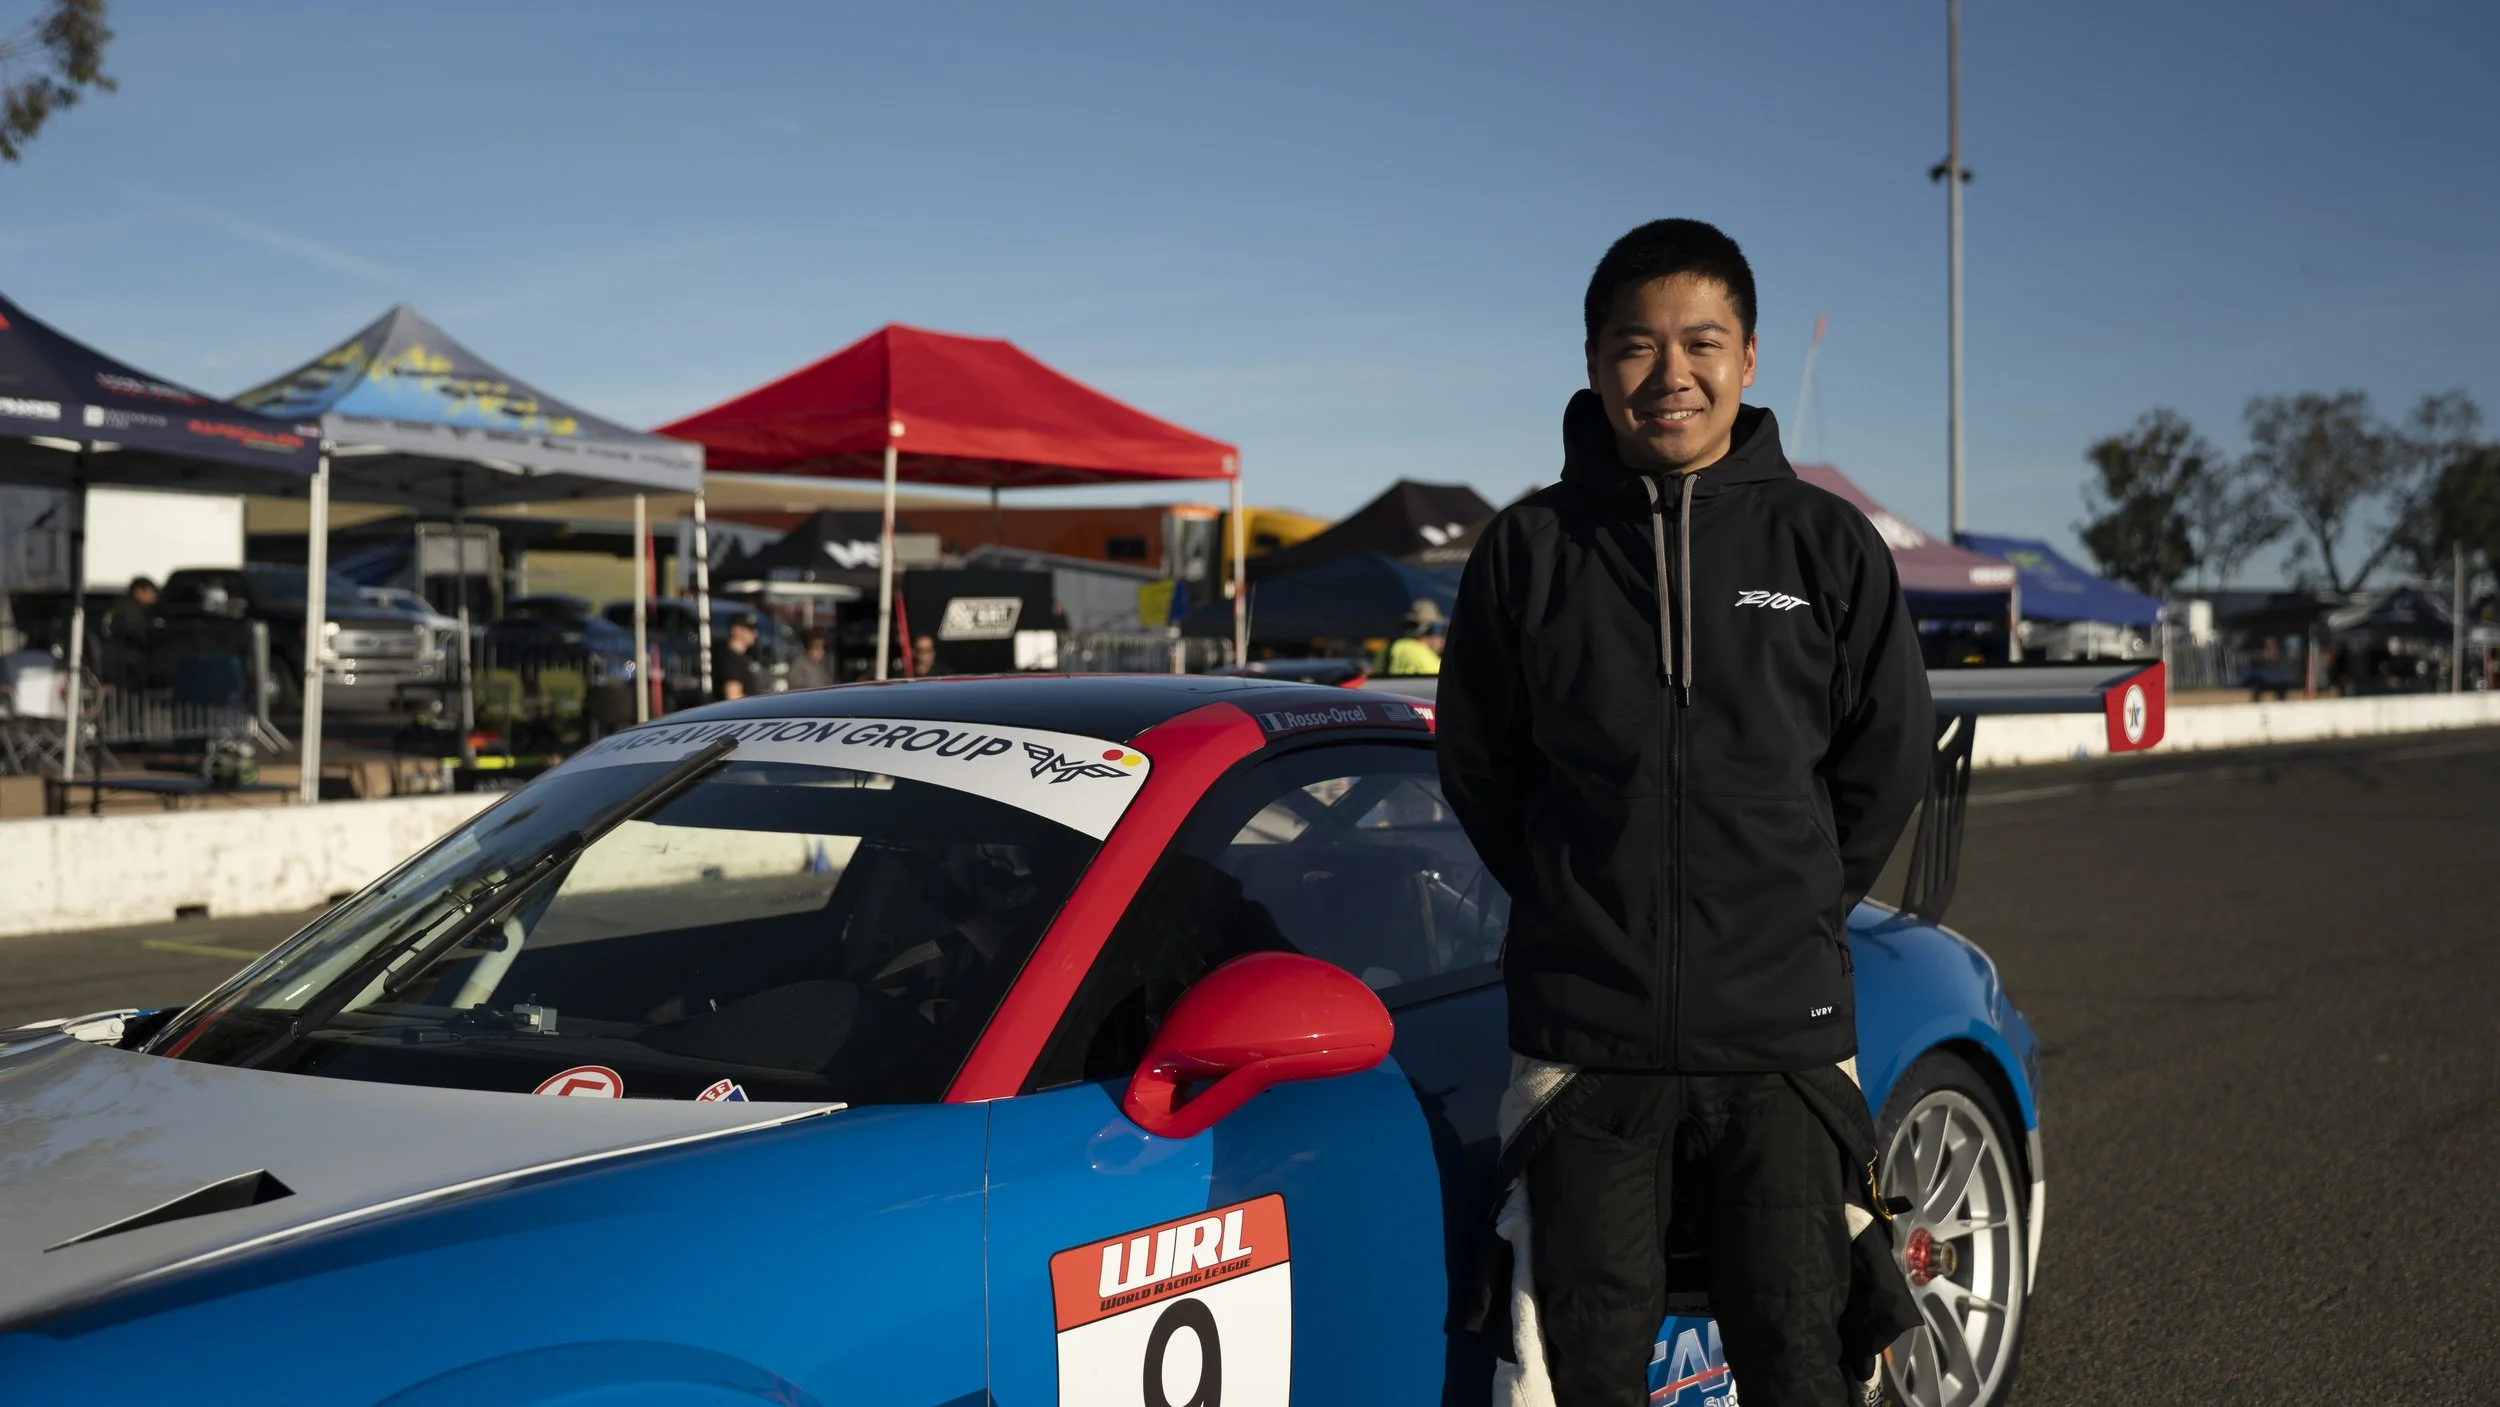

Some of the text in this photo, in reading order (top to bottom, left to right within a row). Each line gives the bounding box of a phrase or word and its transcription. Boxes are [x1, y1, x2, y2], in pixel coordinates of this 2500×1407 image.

[1734, 590, 1810, 611] RIOT
[1283, 703, 1367, 730] Rosso-Orcel
[653, 720, 846, 747] AVIATION
[841, 722, 1013, 762] GROUP
[1811, 1005, 1833, 1018] LVRY
[1098, 1208, 1253, 1298] WRL
[1100, 1257, 1252, 1312] WORLD RACING LEAGUE
[1143, 1298, 1222, 1407] 9
